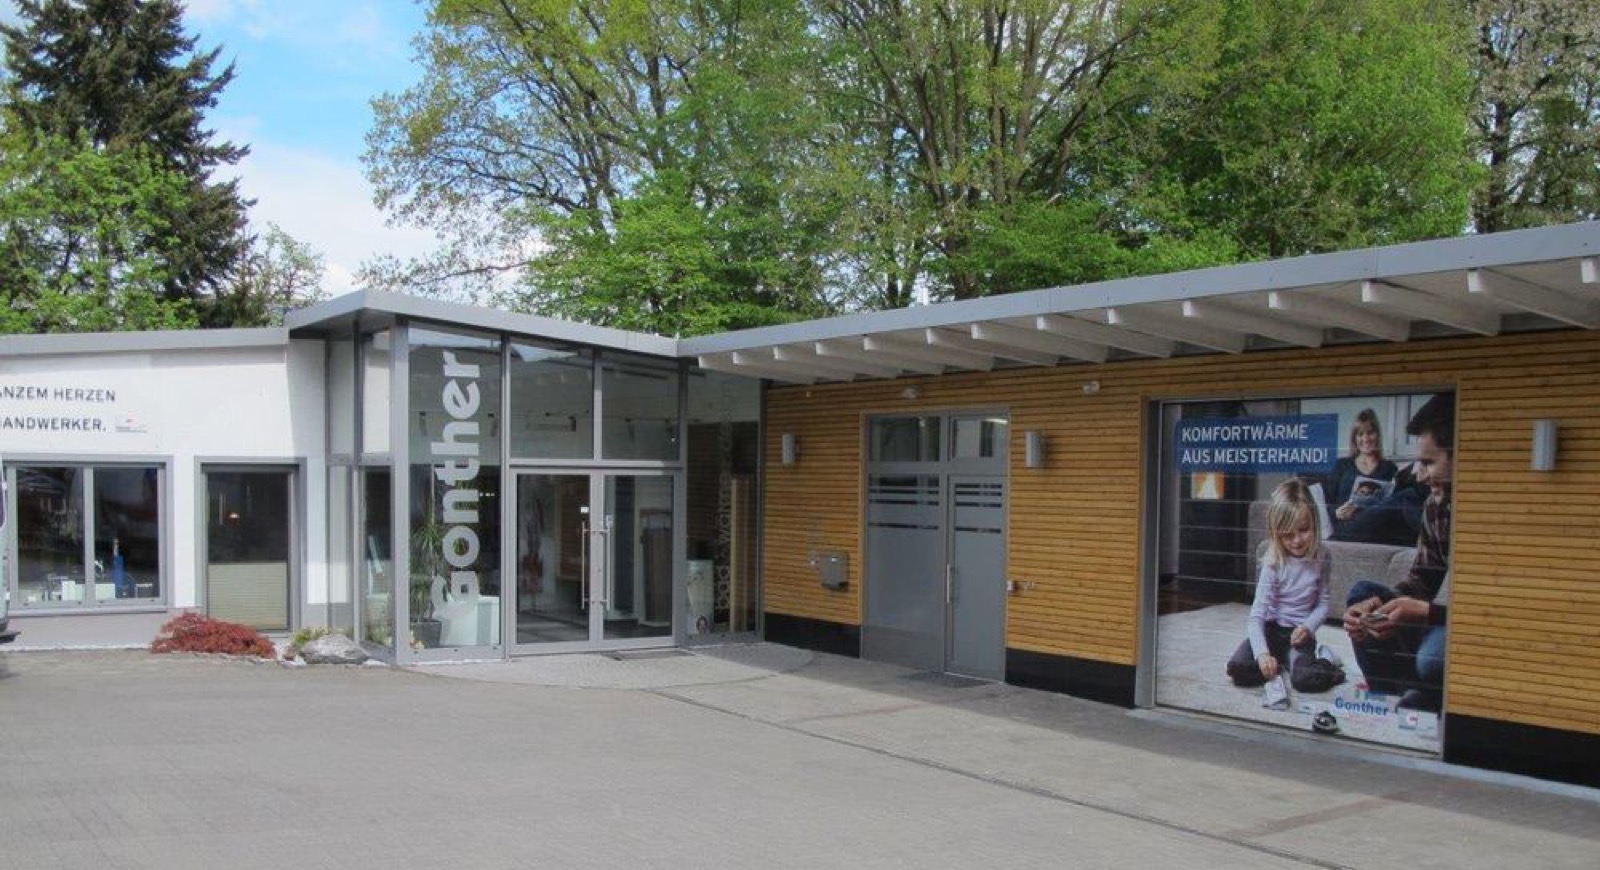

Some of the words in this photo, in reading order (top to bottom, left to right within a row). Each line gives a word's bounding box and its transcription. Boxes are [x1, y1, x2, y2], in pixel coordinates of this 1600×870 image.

[0, 386, 48, 400] NZEM
[54, 388, 116, 402] HERZEN
[0, 416, 107, 432] ANDWERKER.
[1181, 422, 1309, 442] KOMFORTWÄRME
[1181, 449, 1211, 464] AUS
[1214, 448, 1328, 464] MEISTERHAND!
[431, 351, 481, 621] Gonther
[1335, 697, 1389, 716] Gonther
